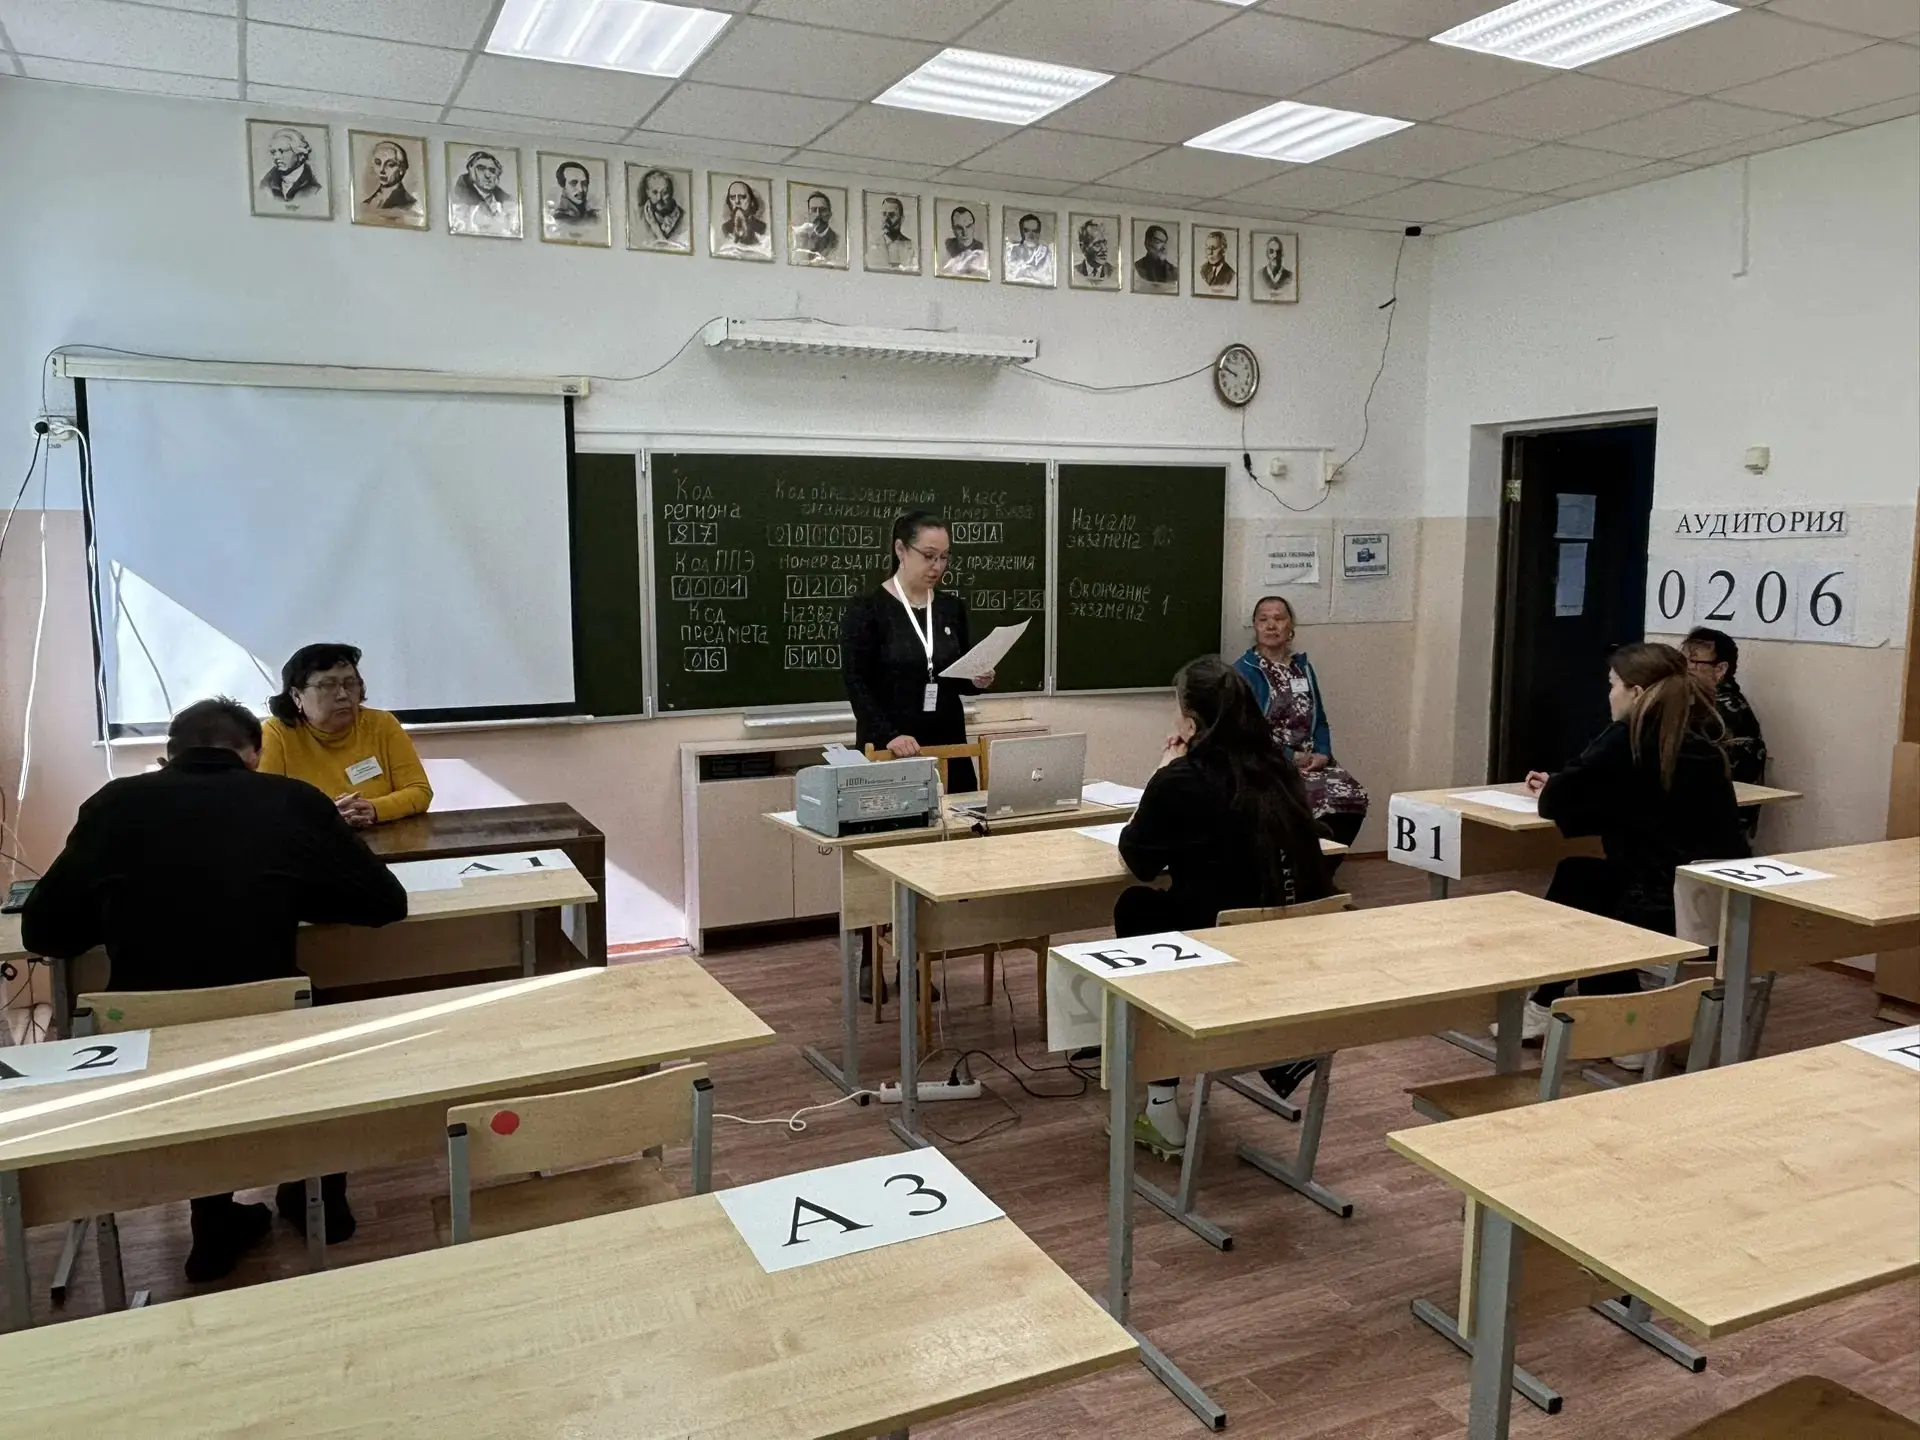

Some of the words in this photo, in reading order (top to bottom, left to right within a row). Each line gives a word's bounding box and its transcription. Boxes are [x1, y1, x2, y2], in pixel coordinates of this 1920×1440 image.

[676, 477, 714, 501] Код
[664, 503, 742, 520] региона
[673, 523, 714, 543] 87
[1675, 511, 1844, 537] АУДИТОРИЯ
[675, 551, 709, 573] Код
[716, 549, 755, 572] ППЭ
[676, 578, 742, 596] 0001
[1658, 570, 1844, 626] 0206
[689, 601, 726, 624] Код
[681, 624, 769, 644] предмета
[690, 650, 723, 669] 06
